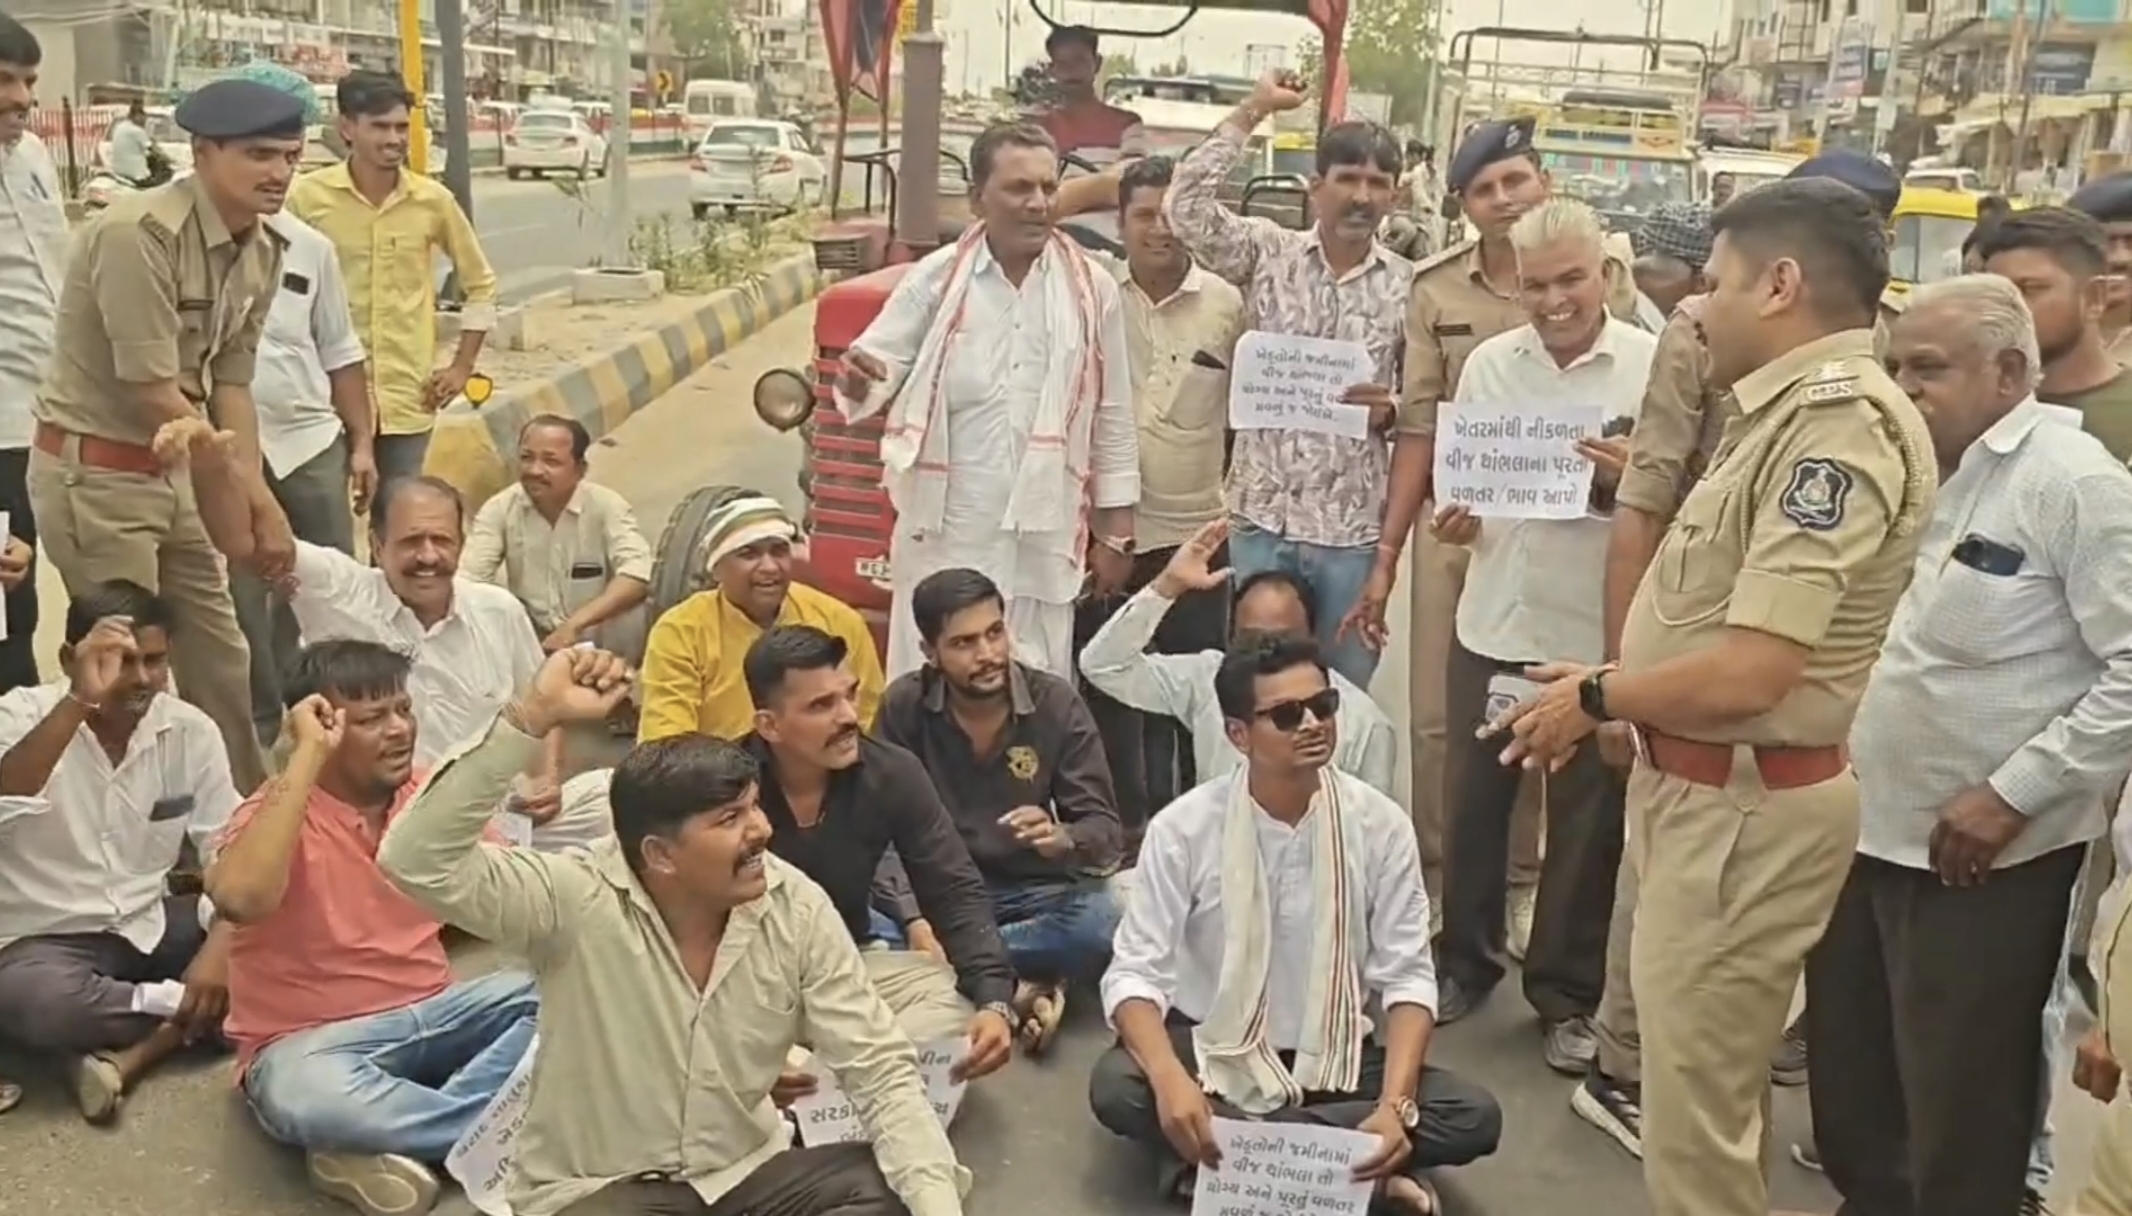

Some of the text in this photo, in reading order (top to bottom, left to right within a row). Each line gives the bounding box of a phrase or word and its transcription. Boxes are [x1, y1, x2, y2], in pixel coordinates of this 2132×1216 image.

[1454, 413, 1521, 440] ખેતરમાંથી
[1445, 446, 1476, 473] વીજ
[1542, 482, 1578, 506] આપો
[1232, 1155, 1262, 1174] વીજ
[1317, 1167, 1334, 1186] તો
[1244, 1183, 1272, 1202] અને
